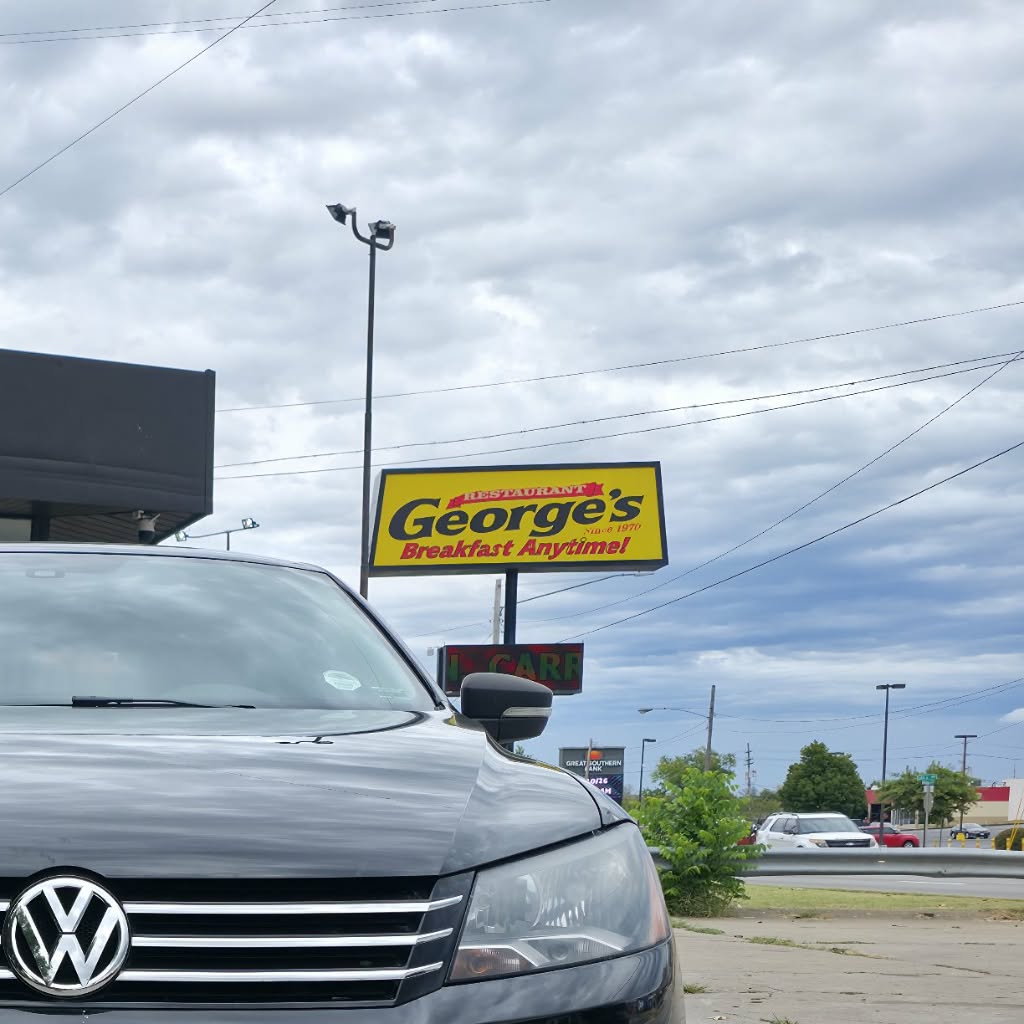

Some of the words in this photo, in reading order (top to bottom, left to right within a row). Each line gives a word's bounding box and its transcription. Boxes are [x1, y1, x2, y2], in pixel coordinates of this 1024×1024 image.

[462, 483, 588, 502] RESTAURANT
[388, 488, 645, 541] George's
[616, 522, 642, 534] 1970
[399, 538, 515, 561] Breakfast
[517, 536, 632, 561] Anytime!
[12, 877, 128, 994] VW
